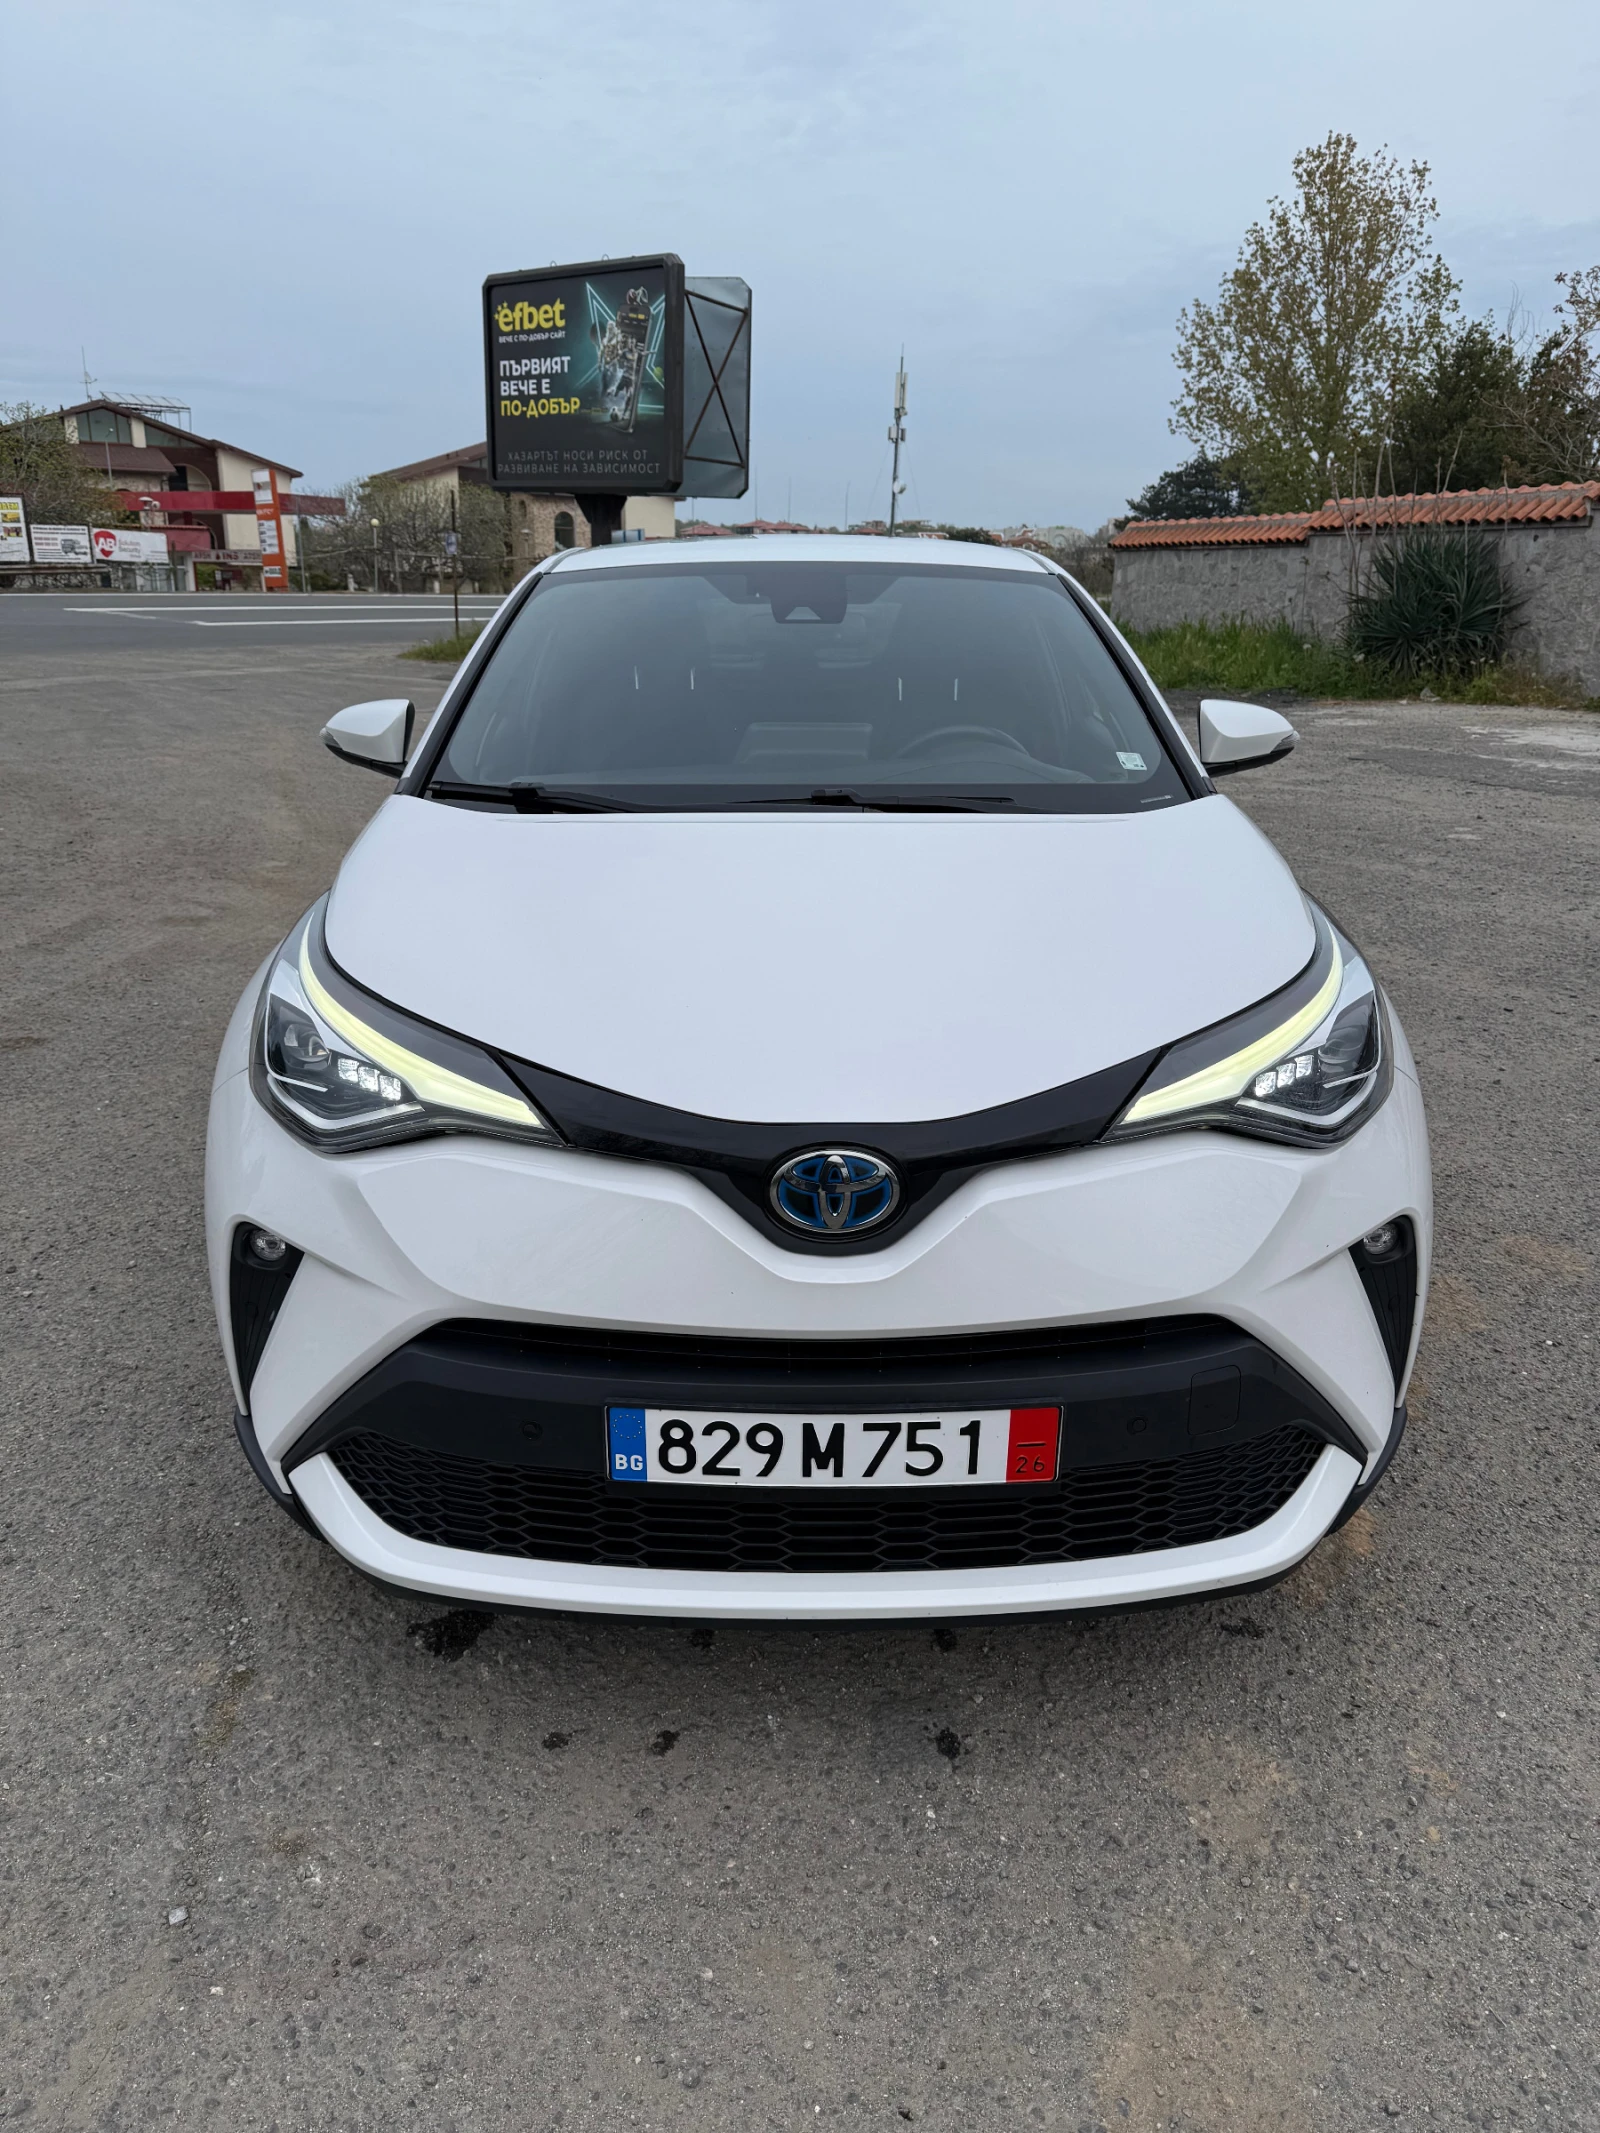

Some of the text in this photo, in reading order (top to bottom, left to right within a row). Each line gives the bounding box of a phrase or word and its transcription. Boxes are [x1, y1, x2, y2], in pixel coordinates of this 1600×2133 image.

[498, 297, 566, 332] efbet
[550, 330, 566, 339] САЙТ
[500, 356, 571, 377] ПЪРВИЯТ
[500, 378, 551, 396] ВЕЧЕ Е
[500, 397, 580, 418] ПО-ДОБЪР
[508, 450, 648, 461] ХАЗАРТЪТ НОСИ РИСК ОТ
[497, 463, 661, 474] РАЗВИВАНЕ НА ЗАВИСИМОСТ
[98, 537, 116, 551] AB
[615, 1454, 644, 1471] BG
[1015, 1455, 1046, 1474] 26
